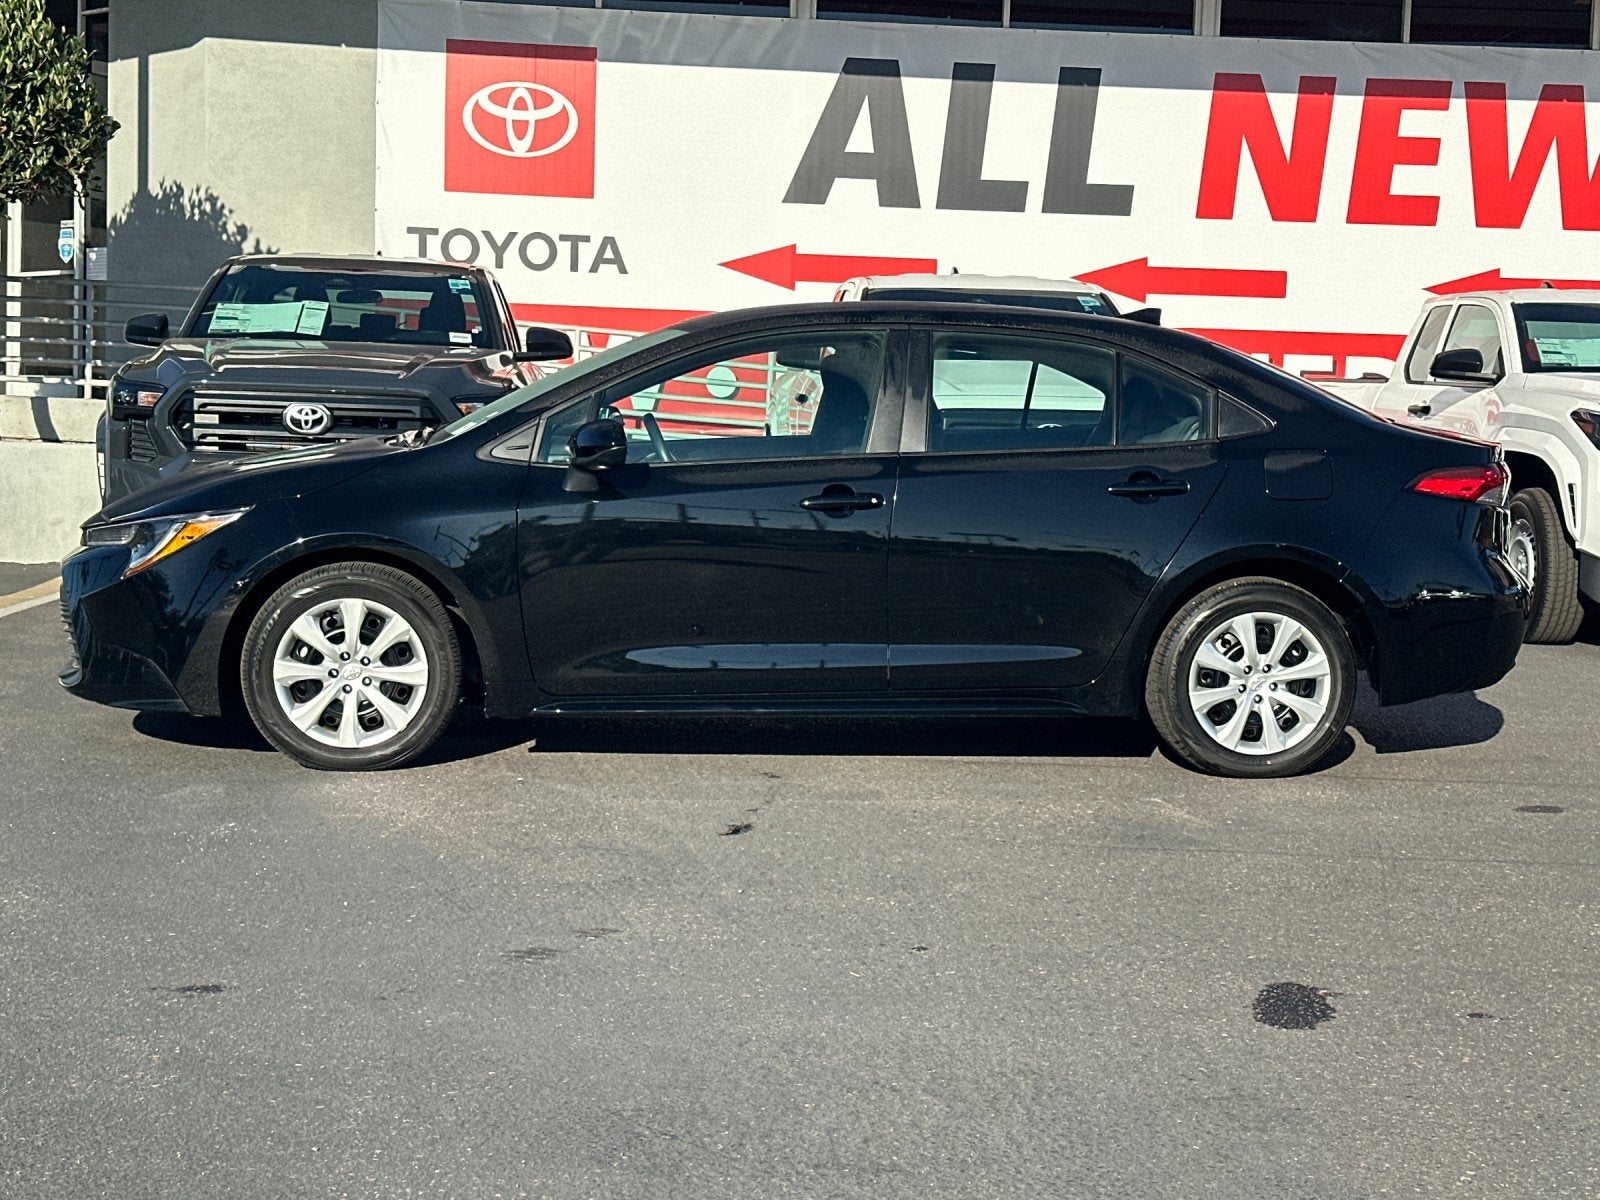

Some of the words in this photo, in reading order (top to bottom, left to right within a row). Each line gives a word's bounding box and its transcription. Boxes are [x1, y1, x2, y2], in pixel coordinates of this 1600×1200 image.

[782, 57, 1135, 216] ALL
[1196, 72, 1600, 231] NEW
[406, 226, 629, 275] TOYOTA
